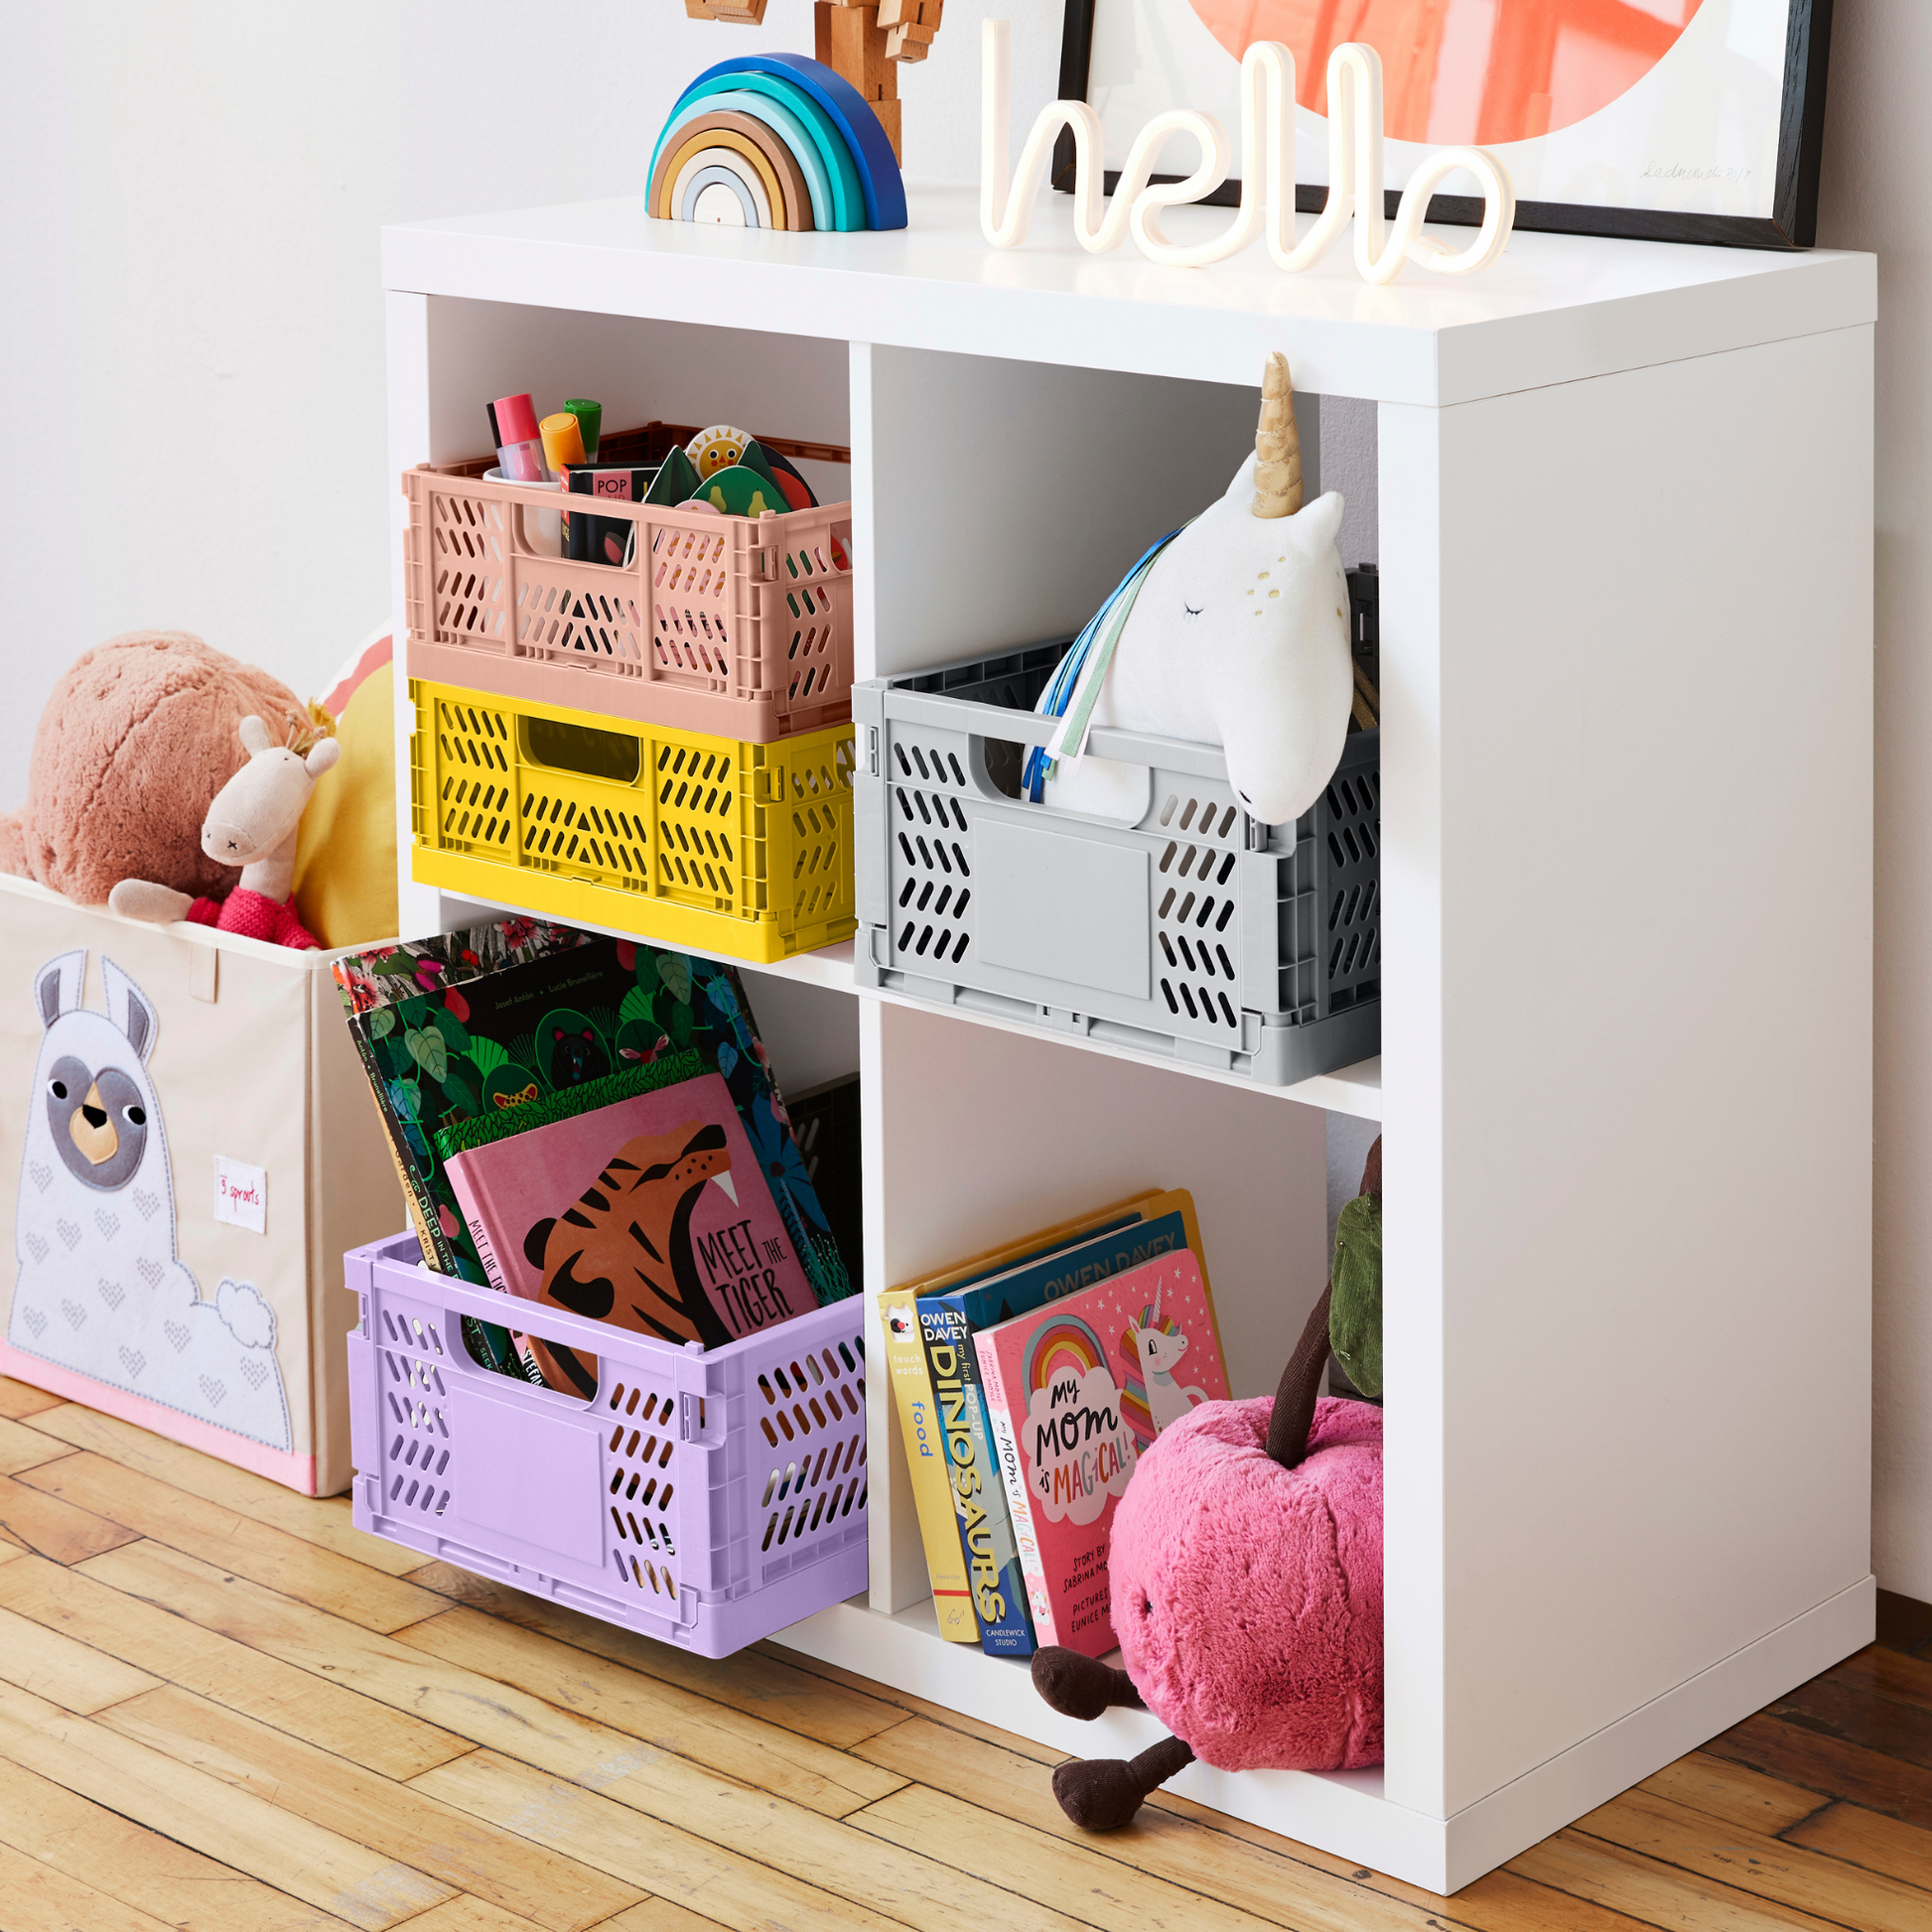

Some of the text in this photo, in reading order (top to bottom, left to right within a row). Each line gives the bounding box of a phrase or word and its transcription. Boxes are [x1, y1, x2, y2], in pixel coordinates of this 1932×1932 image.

[980, 18, 1515, 285] hello
[598, 480, 627, 493] POP
[494, 996, 512, 1010] Josef
[548, 981, 567, 993] Lucie
[229, 1179, 259, 1212] sprouts
[418, 1196, 454, 1272] DEEP IN THE
[469, 1219, 507, 1294] MEET THE TIG
[696, 1219, 787, 1285] MEET THE
[1043, 1231, 1175, 1302] OWEN DAVEY
[715, 1268, 794, 1334] TIGER
[920, 1311, 967, 1326] OWEN
[924, 1325, 968, 1341] DAVEY
[480, 1347, 492, 1371] SEEK
[894, 1354, 921, 1364] touch
[896, 1366, 923, 1375] words
[985, 1350, 997, 1380] SABRINA
[979, 1350, 996, 1402] EUNICE MOYLE
[957, 1344, 984, 1441] my first POP-UP
[911, 1401, 933, 1457] food
[929, 1345, 1006, 1626] DINOSAURS
[1013, 1489, 1022, 1498] is
[1039, 1468, 1049, 1493] is
[1073, 1544, 1105, 1572] STORY BY
[1063, 1568, 1095, 1592] SABRINA
[1073, 1587, 1108, 1616] PICTURES
[1071, 1609, 1099, 1633] EUNICE
